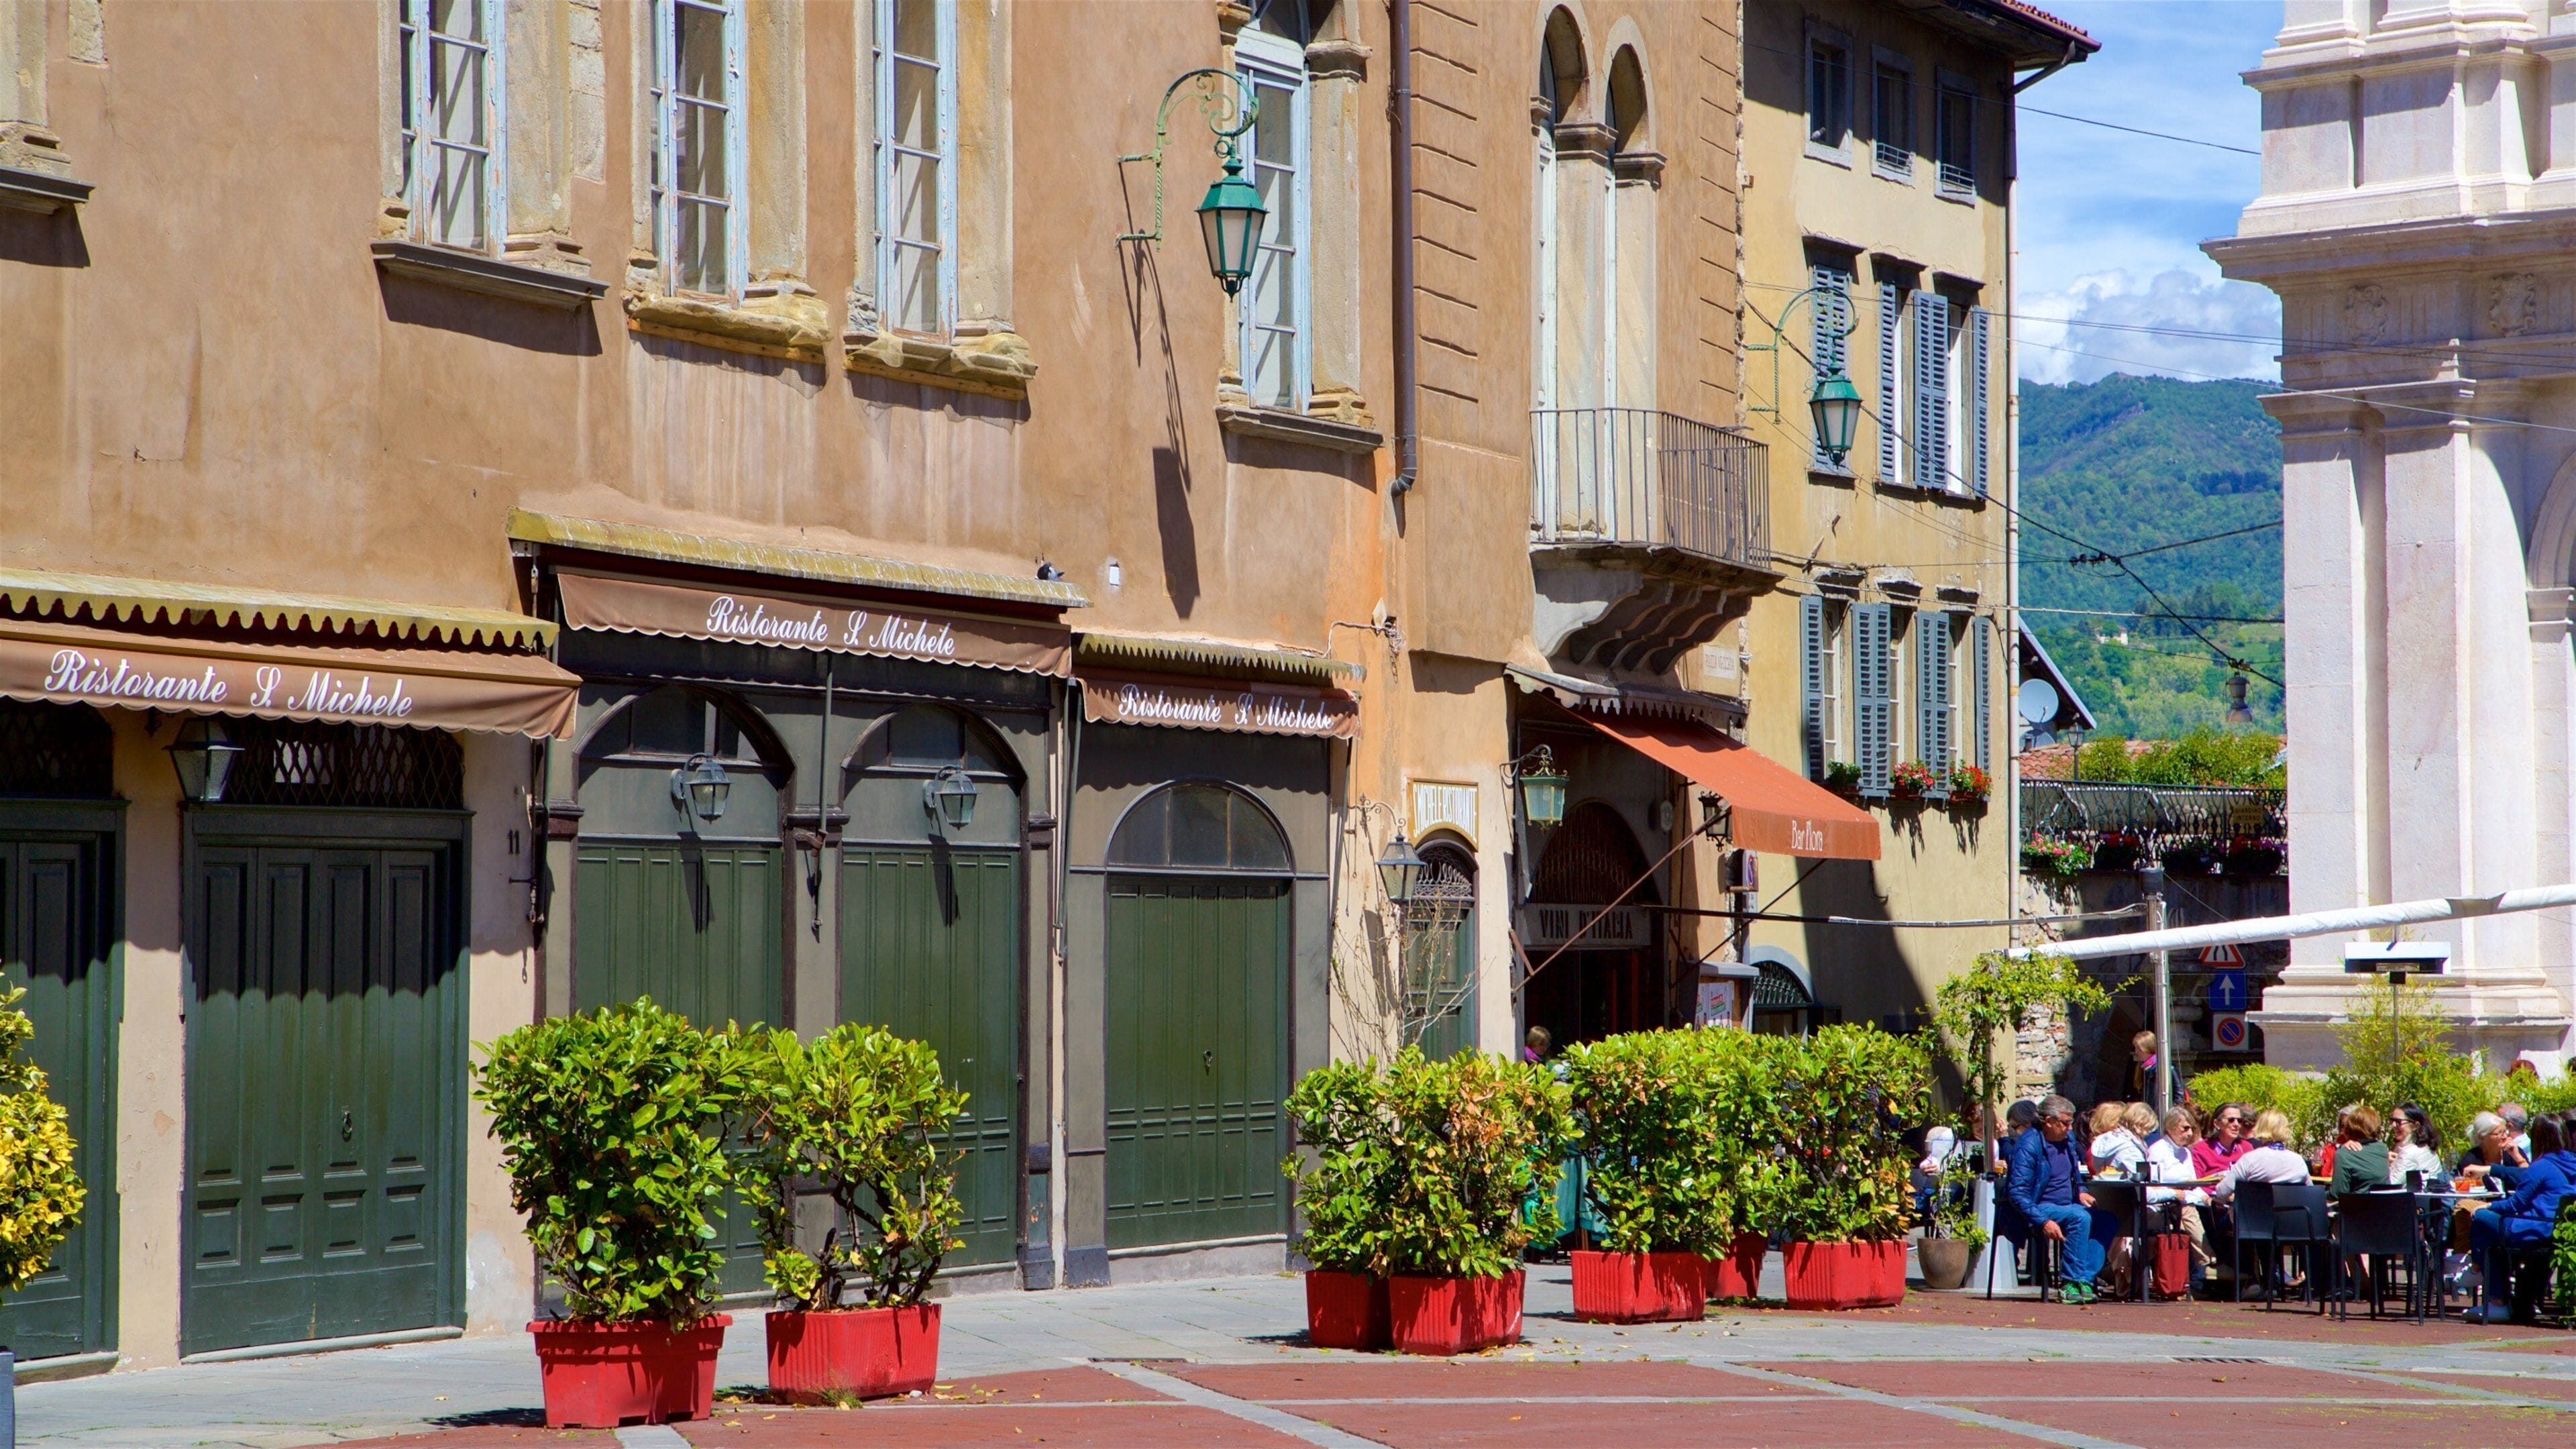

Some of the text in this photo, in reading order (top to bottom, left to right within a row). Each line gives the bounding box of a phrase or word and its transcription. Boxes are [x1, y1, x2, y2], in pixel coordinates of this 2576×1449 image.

[706, 596, 828, 642] Ristorante
[869, 614, 956, 655] Michele
[44, 649, 228, 704] Ristorante
[287, 671, 413, 718] Michele
[1118, 683, 1222, 723] Ristorante
[1256, 696, 1334, 730] Michele
[508, 829, 520, 855] 11
[1791, 819, 1823, 851] Bar Flora
[1540, 910, 1569, 938] VINI
